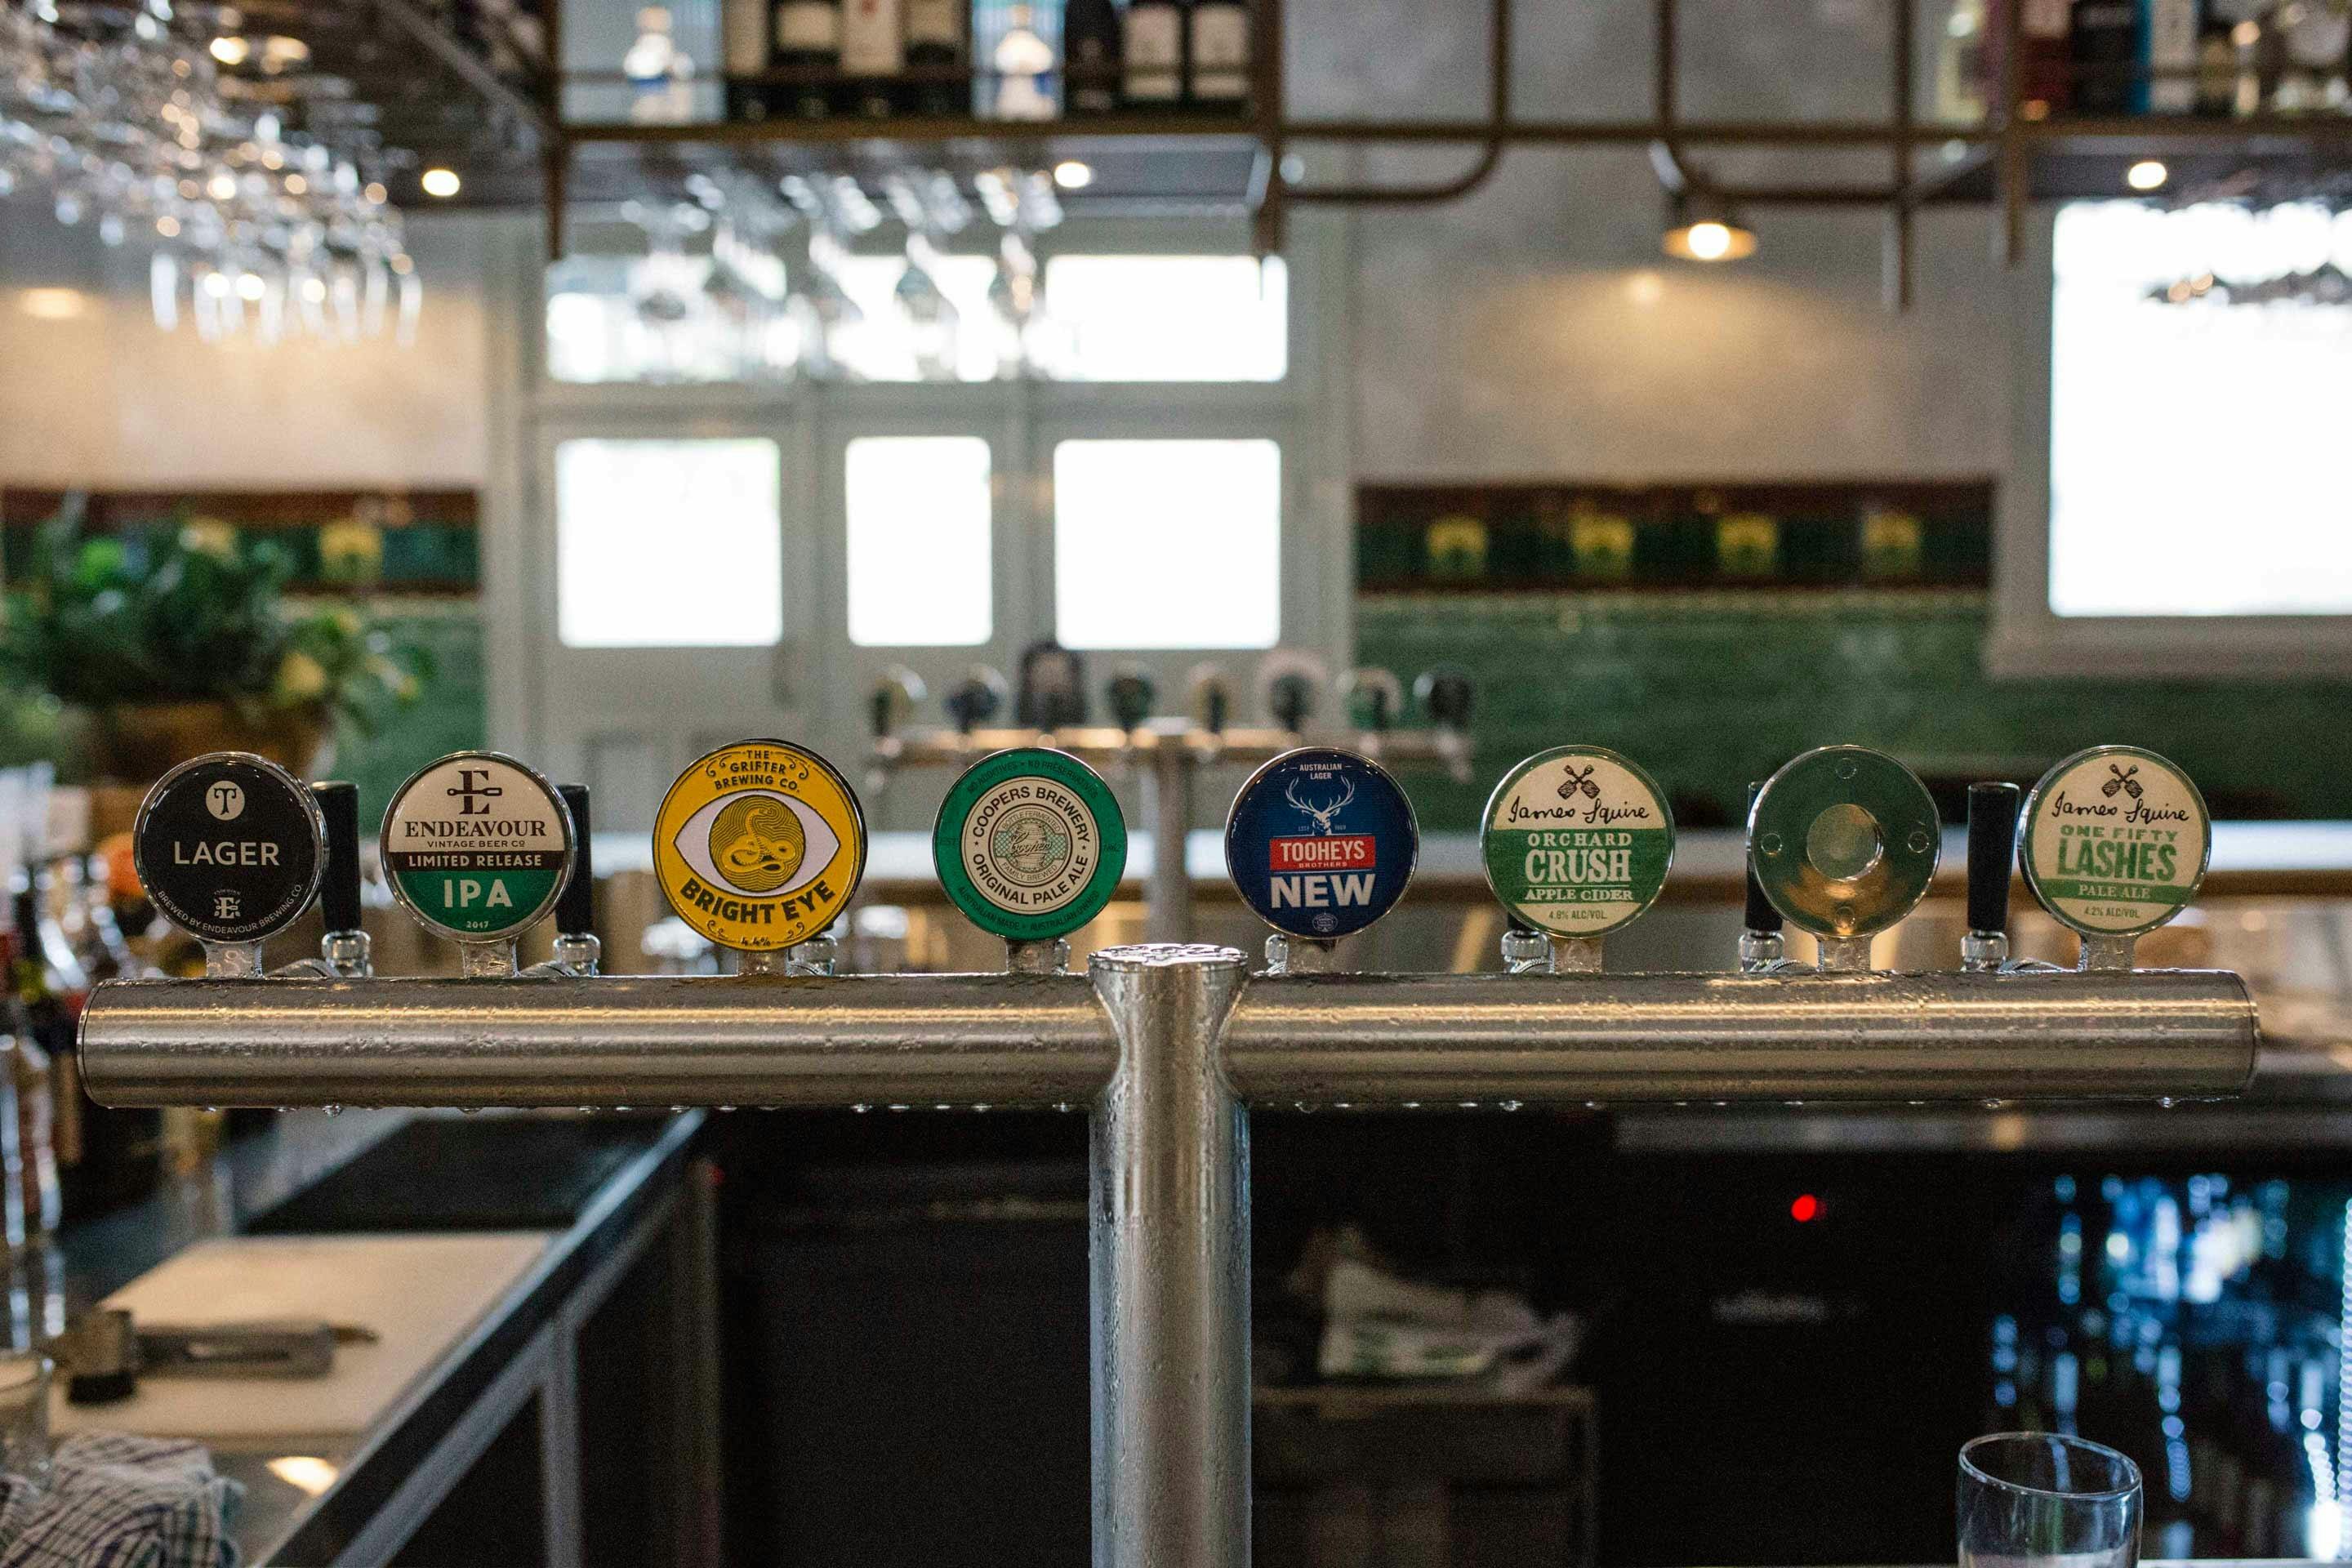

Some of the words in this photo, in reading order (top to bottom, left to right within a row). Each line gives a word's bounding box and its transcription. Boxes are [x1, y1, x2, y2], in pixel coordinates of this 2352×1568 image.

[746, 750, 770, 759] THE
[729, 761, 786, 774] GRIFTER
[1299, 764, 1343, 772] AUSTRALIAN
[1310, 772, 1333, 780] LAGER
[714, 774, 775, 791] BREWING
[779, 778, 800, 794] CO.
[214, 787, 237, 815] T
[1508, 795, 1575, 823] James
[1582, 798, 1650, 824] Squire
[2051, 791, 2118, 817] James
[2123, 798, 2189, 824] Squire
[973, 786, 1031, 838] COOPERS
[1036, 786, 1091, 844] BREWERY
[1001, 812, 1024, 831] BOTTLE
[1025, 810, 1061, 831] FERMENTED
[405, 820, 547, 837] ENDEAVOUR
[2060, 825, 2105, 838] ONE
[2112, 827, 2178, 842] FIFTY
[1527, 832, 1633, 847] ORCHARD
[174, 841, 280, 866] LAGER
[408, 855, 470, 867] LIMITED
[476, 855, 542, 866] RELEASE
[1280, 840, 1365, 862] TOOHEYS
[2057, 838, 2177, 881] LASHES
[1001, 862, 1026, 880] FAMILY
[1027, 864, 1058, 881] BREWED
[1525, 849, 1632, 884] CRUSH
[973, 853, 1029, 905] ORIGINAL
[1032, 880, 1070, 905] PALE
[1071, 855, 1089, 885] ALE
[443, 879, 513, 908] IPA
[679, 877, 776, 924] BRIGHT
[782, 880, 836, 921] EYE
[1271, 873, 1376, 909] NEW
[1524, 889, 1576, 900] APPLE
[1580, 889, 1633, 900] CIDER
[2078, 884, 2116, 897] PALE
[2122, 885, 2150, 898] ALE
[157, 890, 189, 921] BREWED
[189, 918, 202, 929] BY
[202, 922, 258, 934] ENDEAVOUR
[258, 898, 295, 929] BREWING
[466, 920, 489, 929] 2017
[740, 937, 772, 947] 4.4%
